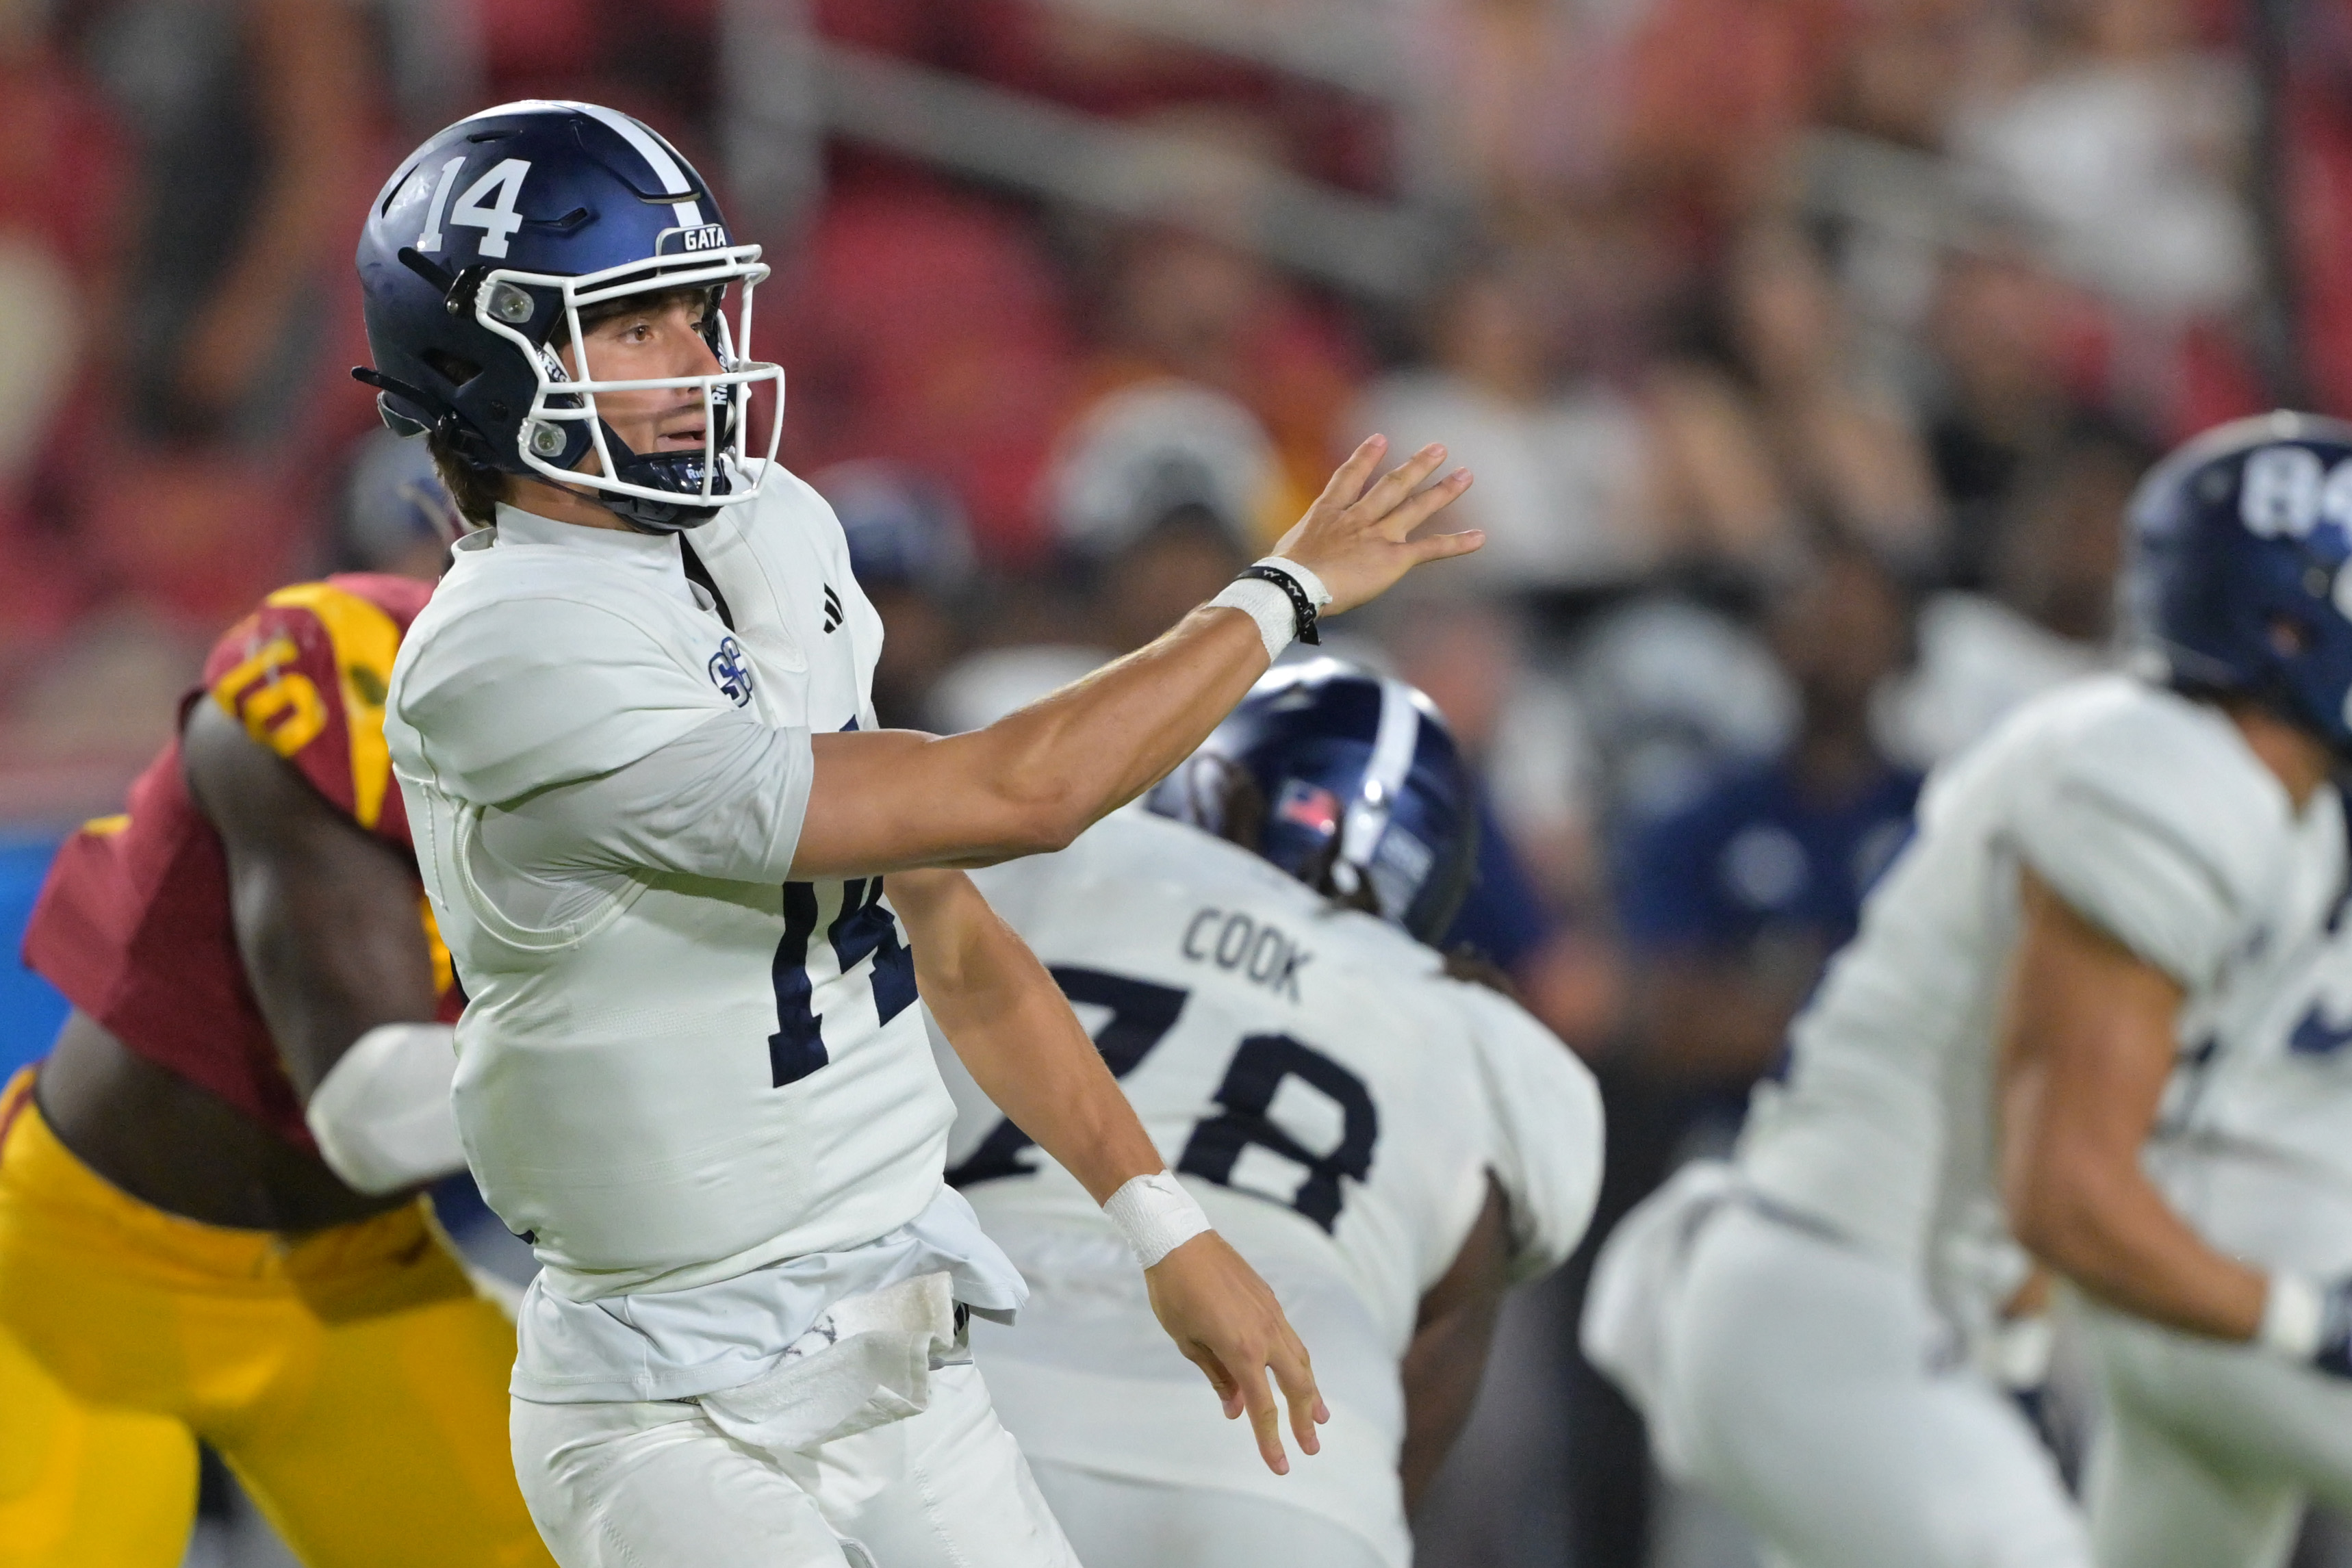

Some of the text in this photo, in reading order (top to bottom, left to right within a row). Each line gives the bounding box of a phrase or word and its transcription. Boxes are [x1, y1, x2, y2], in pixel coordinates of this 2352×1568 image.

[417, 156, 532, 259] 14
[685, 227, 727, 250] GATA
[769, 875, 919, 1088] 14
[1181, 906, 1314, 1003] COOK
[943, 961, 1379, 1237] 78
